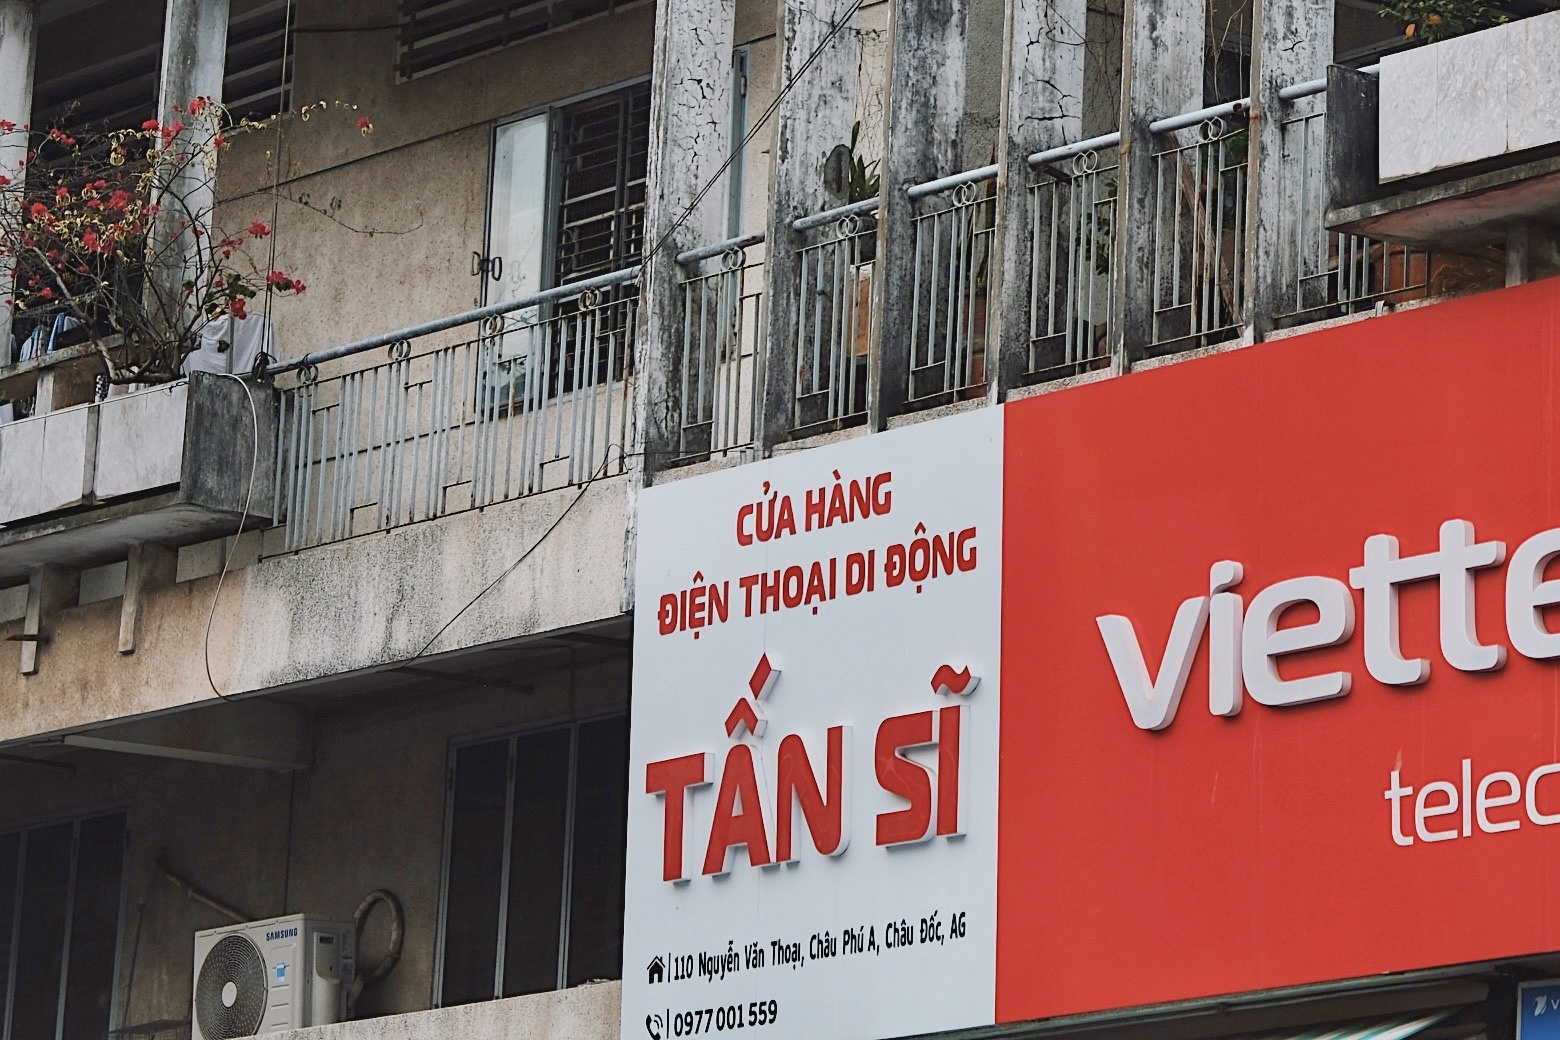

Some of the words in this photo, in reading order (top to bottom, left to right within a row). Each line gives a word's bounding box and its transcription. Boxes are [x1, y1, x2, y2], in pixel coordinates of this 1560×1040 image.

[736, 481, 797, 546] CỬA
[805, 470, 892, 531] HÀNG
[657, 572, 729, 639] ĐIỆN
[739, 558, 837, 617] THOẠI
[845, 550, 875, 596] DI
[884, 523, 977, 593] ĐỘNG
[645, 652, 854, 882] TẤN
[874, 664, 981, 846] SĨ
[266, 927, 298, 942] SAMSUNG
[673, 954, 694, 981] 110
[698, 939, 740, 983] Nguyễn
[744, 941, 765, 970] Văn
[809, 930, 837, 961] Châu
[842, 925, 865, 956] Phú
[867, 925, 880, 957] A,
[885, 918, 914, 949] Châu
[919, 909, 945, 946] Đốc,
[949, 911, 966, 940] AG
